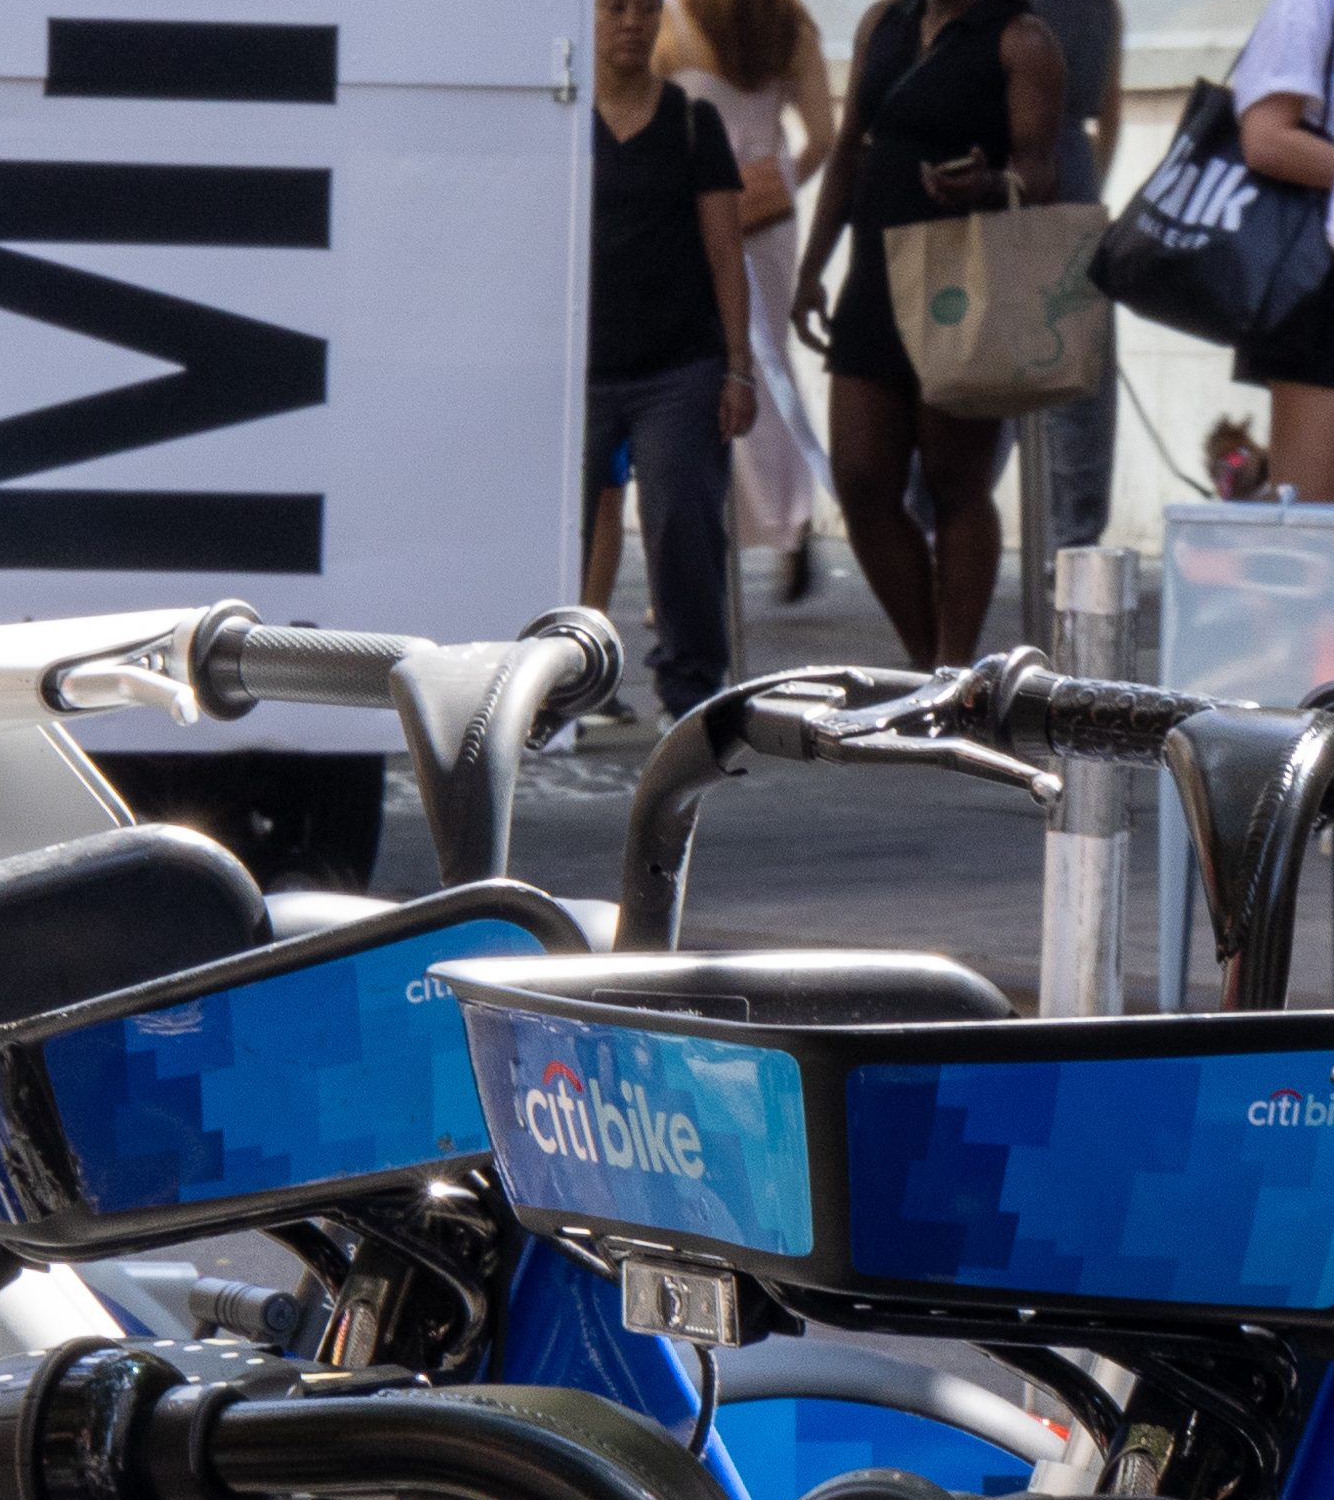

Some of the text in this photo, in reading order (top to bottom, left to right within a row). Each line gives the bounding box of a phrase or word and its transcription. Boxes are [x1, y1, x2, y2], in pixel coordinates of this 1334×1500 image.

[406, 971, 453, 1004] cit
[526, 1063, 705, 1179] citi bike
[1245, 1088, 1301, 1127] citi
